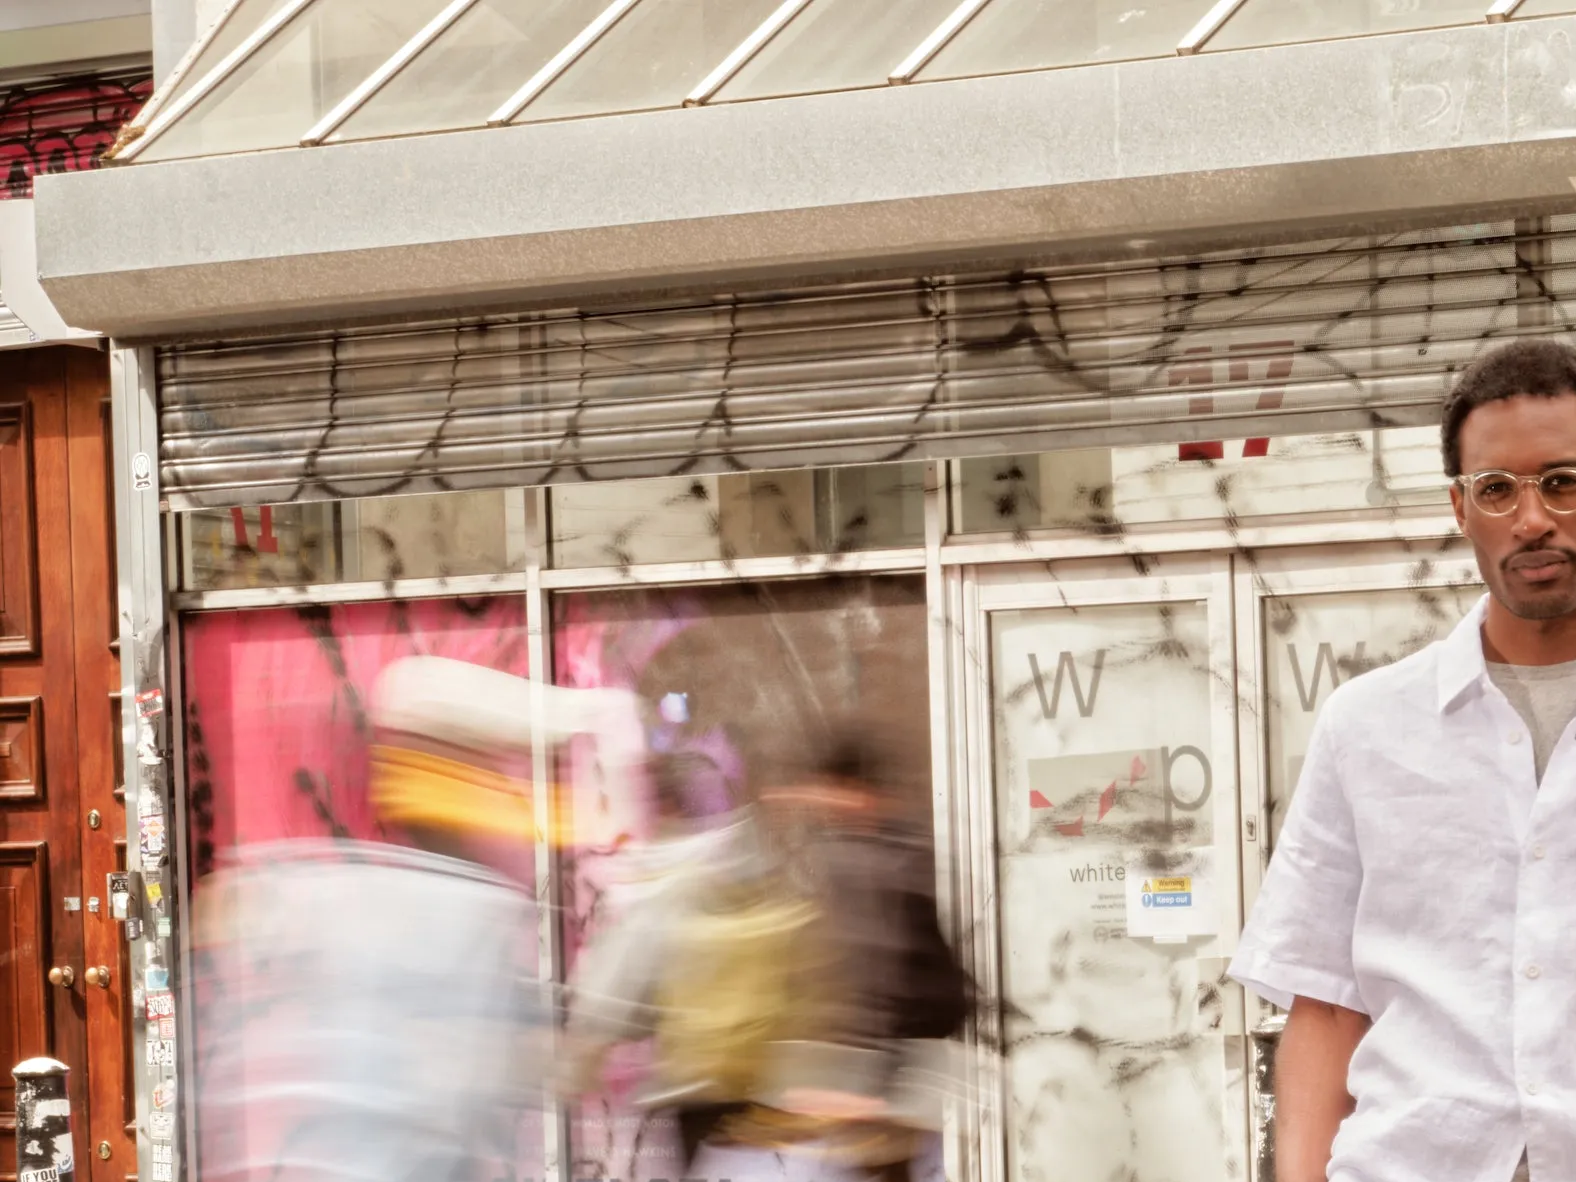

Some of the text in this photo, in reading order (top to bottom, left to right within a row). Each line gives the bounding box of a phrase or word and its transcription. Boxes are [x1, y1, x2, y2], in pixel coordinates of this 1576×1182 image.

[1168, 340, 1294, 461] 17
[1161, 744, 1213, 842] p
[1070, 863, 1126, 882] white
[1158, 879, 1185, 888] Warning
[1156, 895, 1188, 905] Keep out
[34, 1168, 57, 1182] YOU
